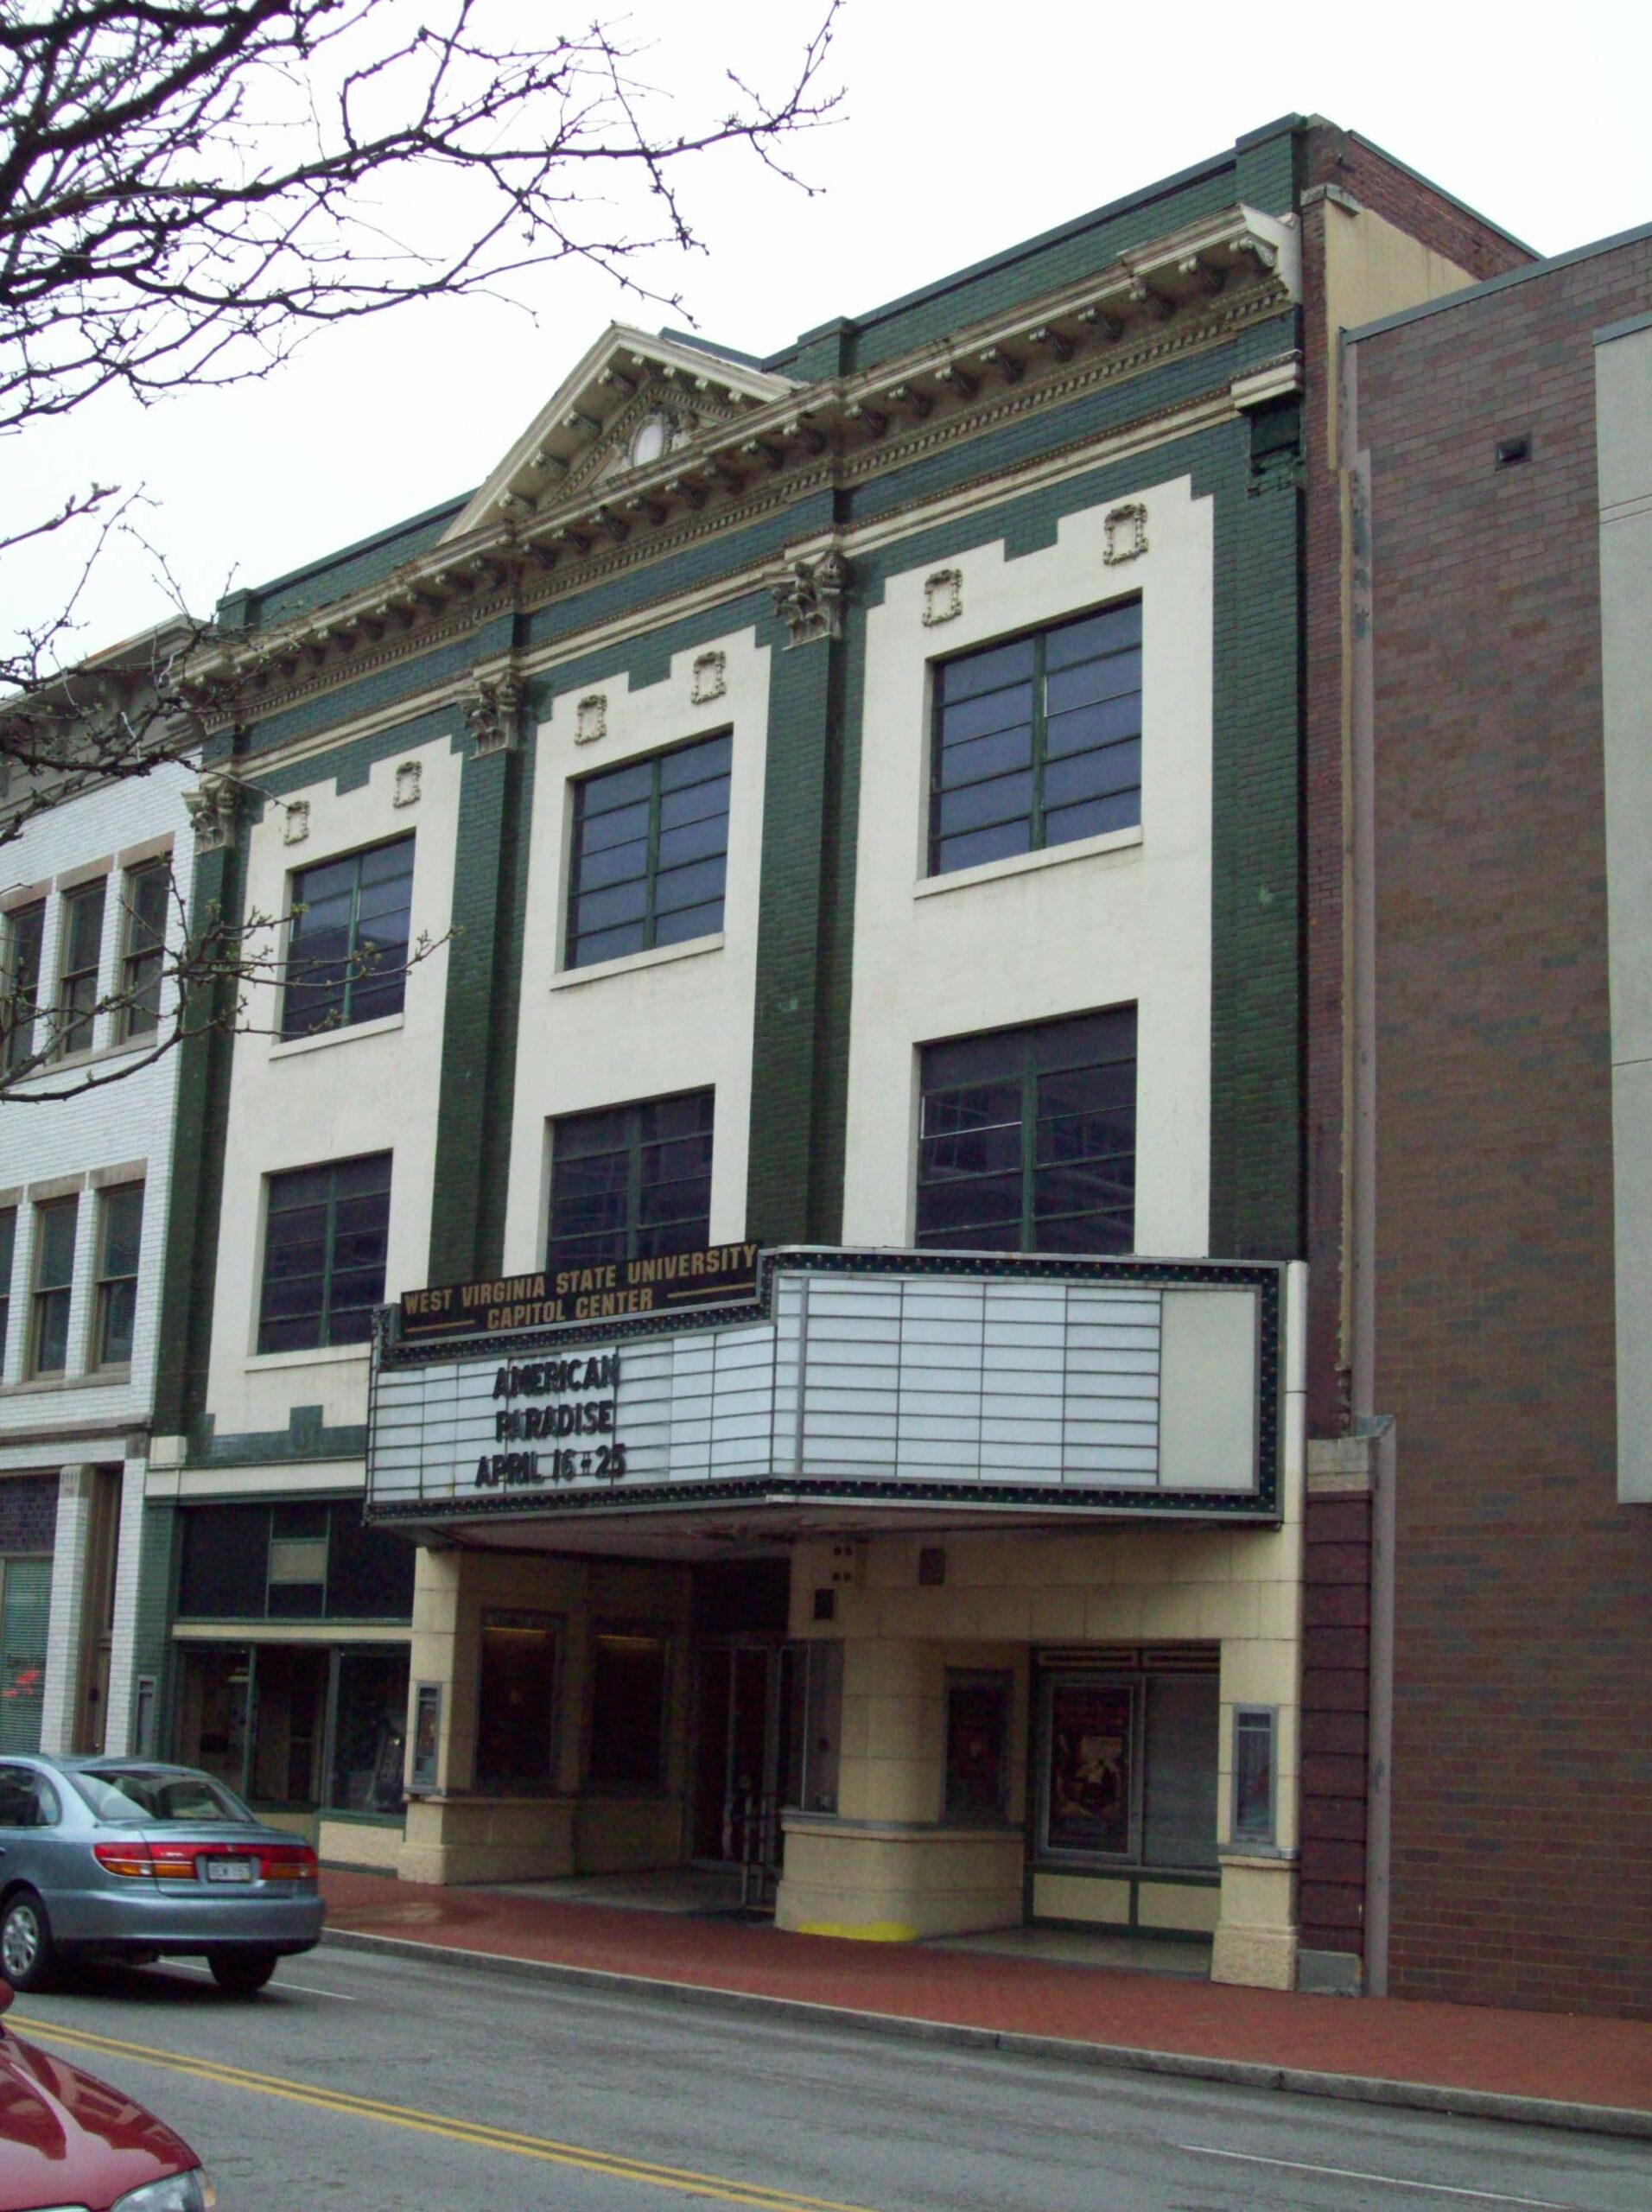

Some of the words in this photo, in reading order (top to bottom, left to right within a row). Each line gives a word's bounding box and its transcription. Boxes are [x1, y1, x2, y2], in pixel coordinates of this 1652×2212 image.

[405, 1288, 453, 1315] WEST
[462, 1275, 545, 1307] VIRGINIA
[556, 1265, 617, 1294] STATE
[627, 1244, 758, 1284] UNIVERSITY
[487, 1300, 566, 1330] CAPITOL
[575, 1288, 653, 1319] CENTER
[492, 1354, 620, 1400] AMERICAN
[496, 1400, 617, 1442] PARADISE
[475, 1451, 545, 1487] APRIL
